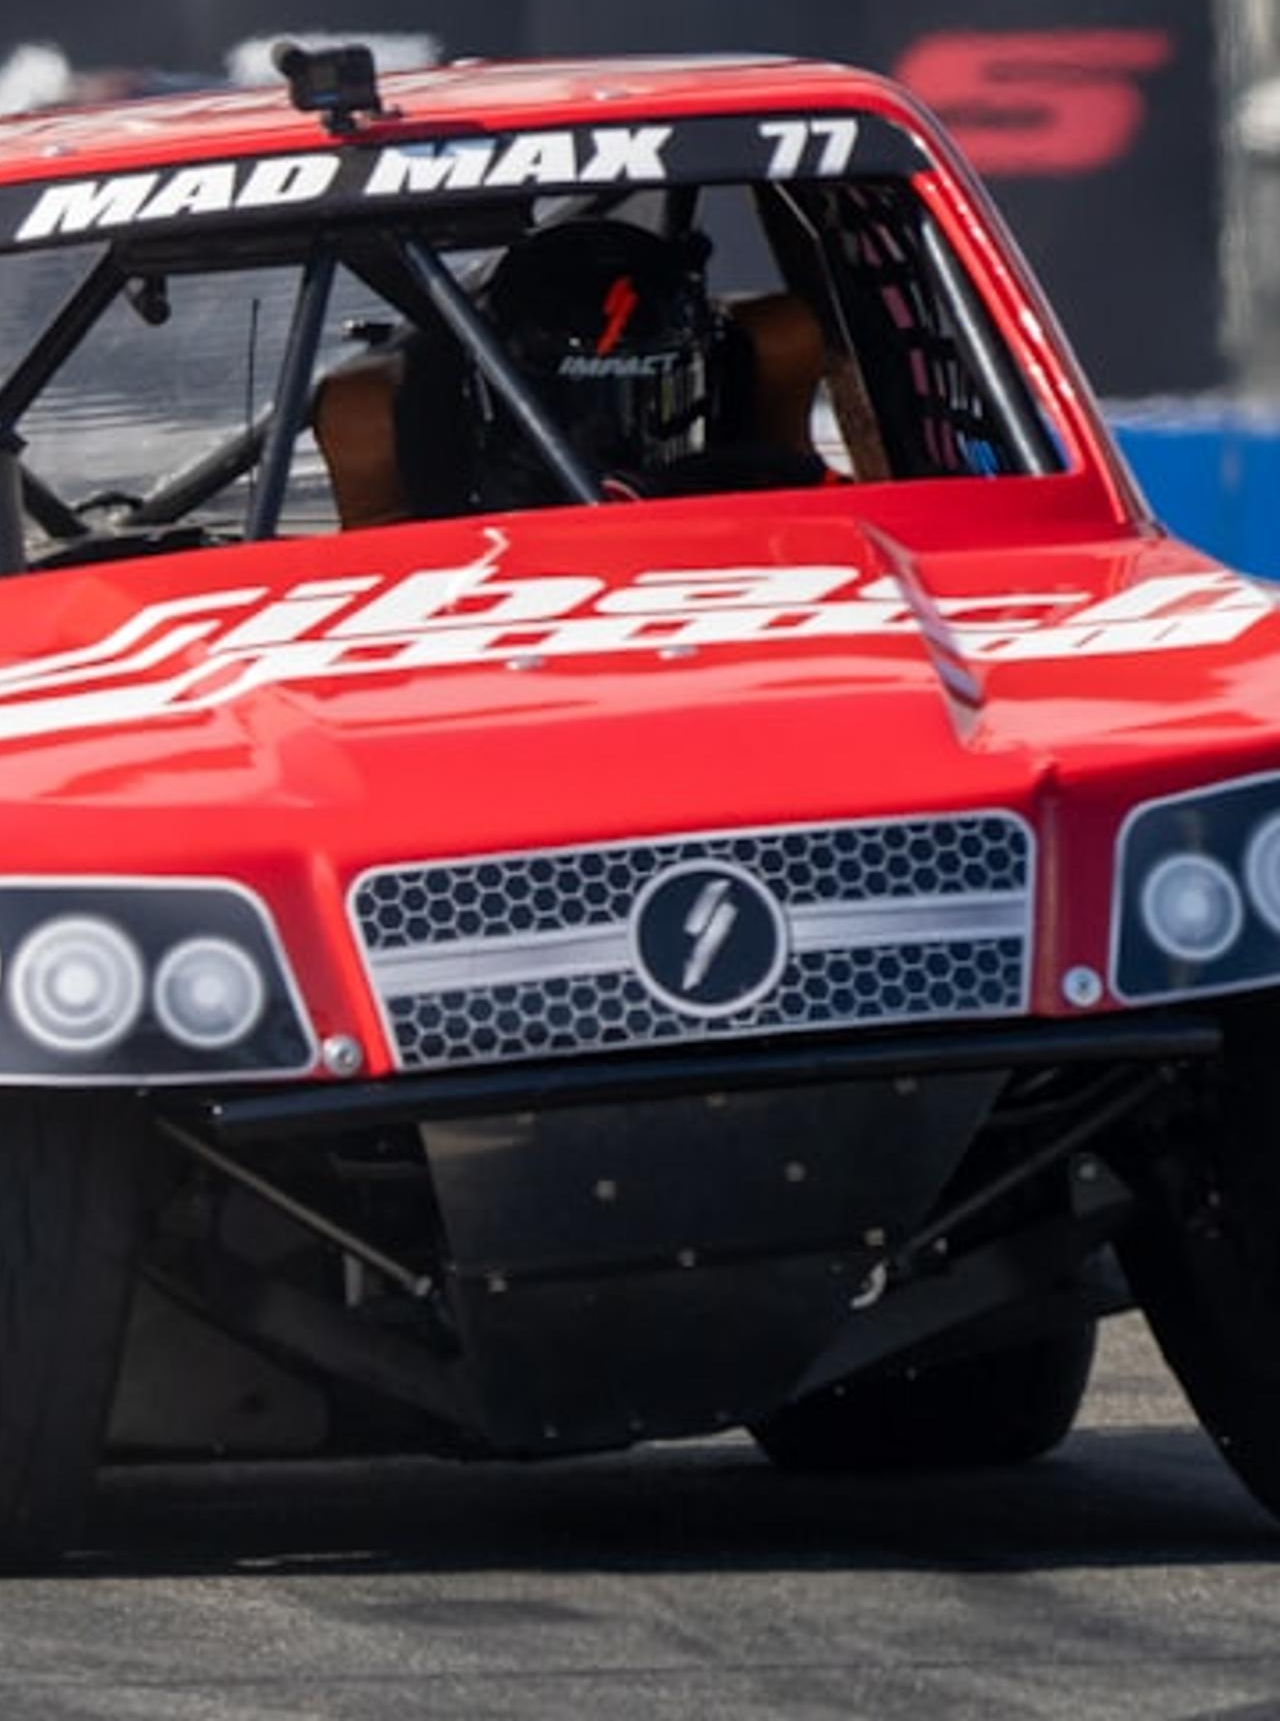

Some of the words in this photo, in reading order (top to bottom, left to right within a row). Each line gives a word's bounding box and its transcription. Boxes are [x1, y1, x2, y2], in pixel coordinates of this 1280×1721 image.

[15, 153, 340, 243] MAD
[363, 125, 674, 197] MAX
[756, 119, 860, 178] 77
[558, 352, 680, 377] IMPACT
